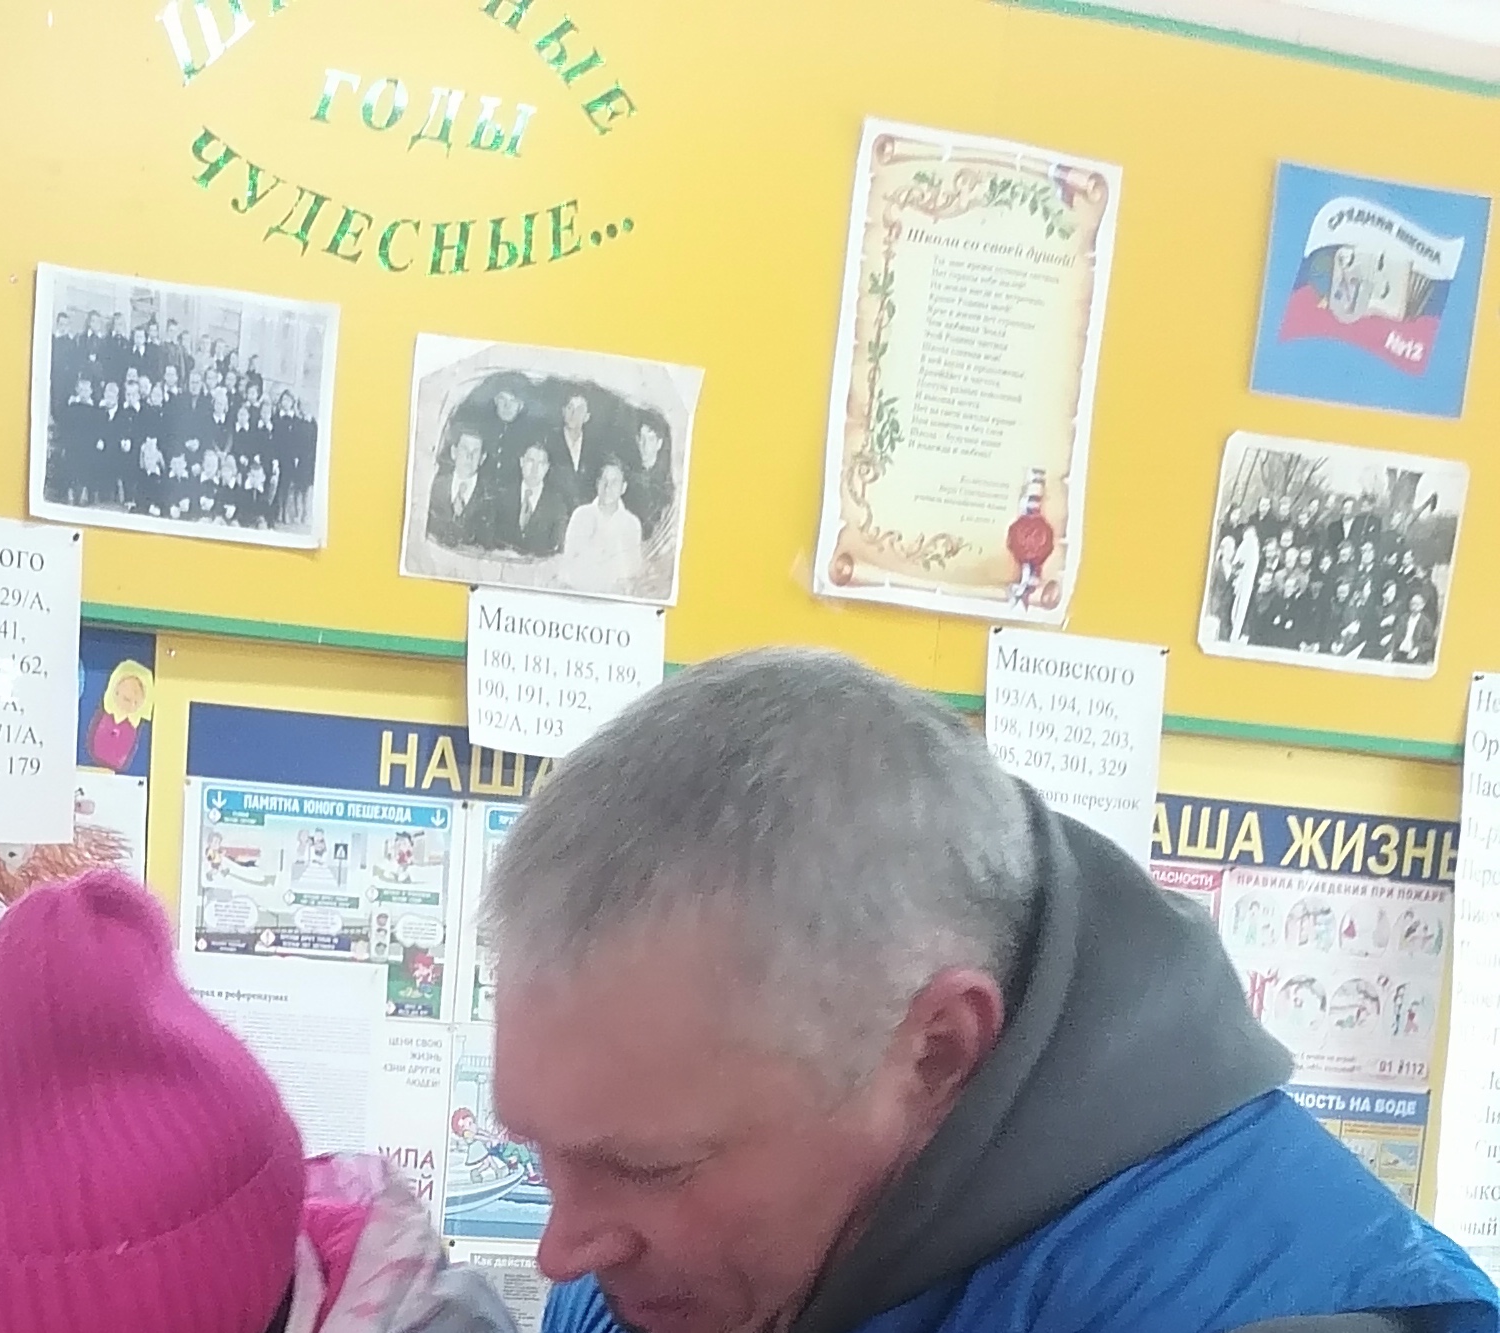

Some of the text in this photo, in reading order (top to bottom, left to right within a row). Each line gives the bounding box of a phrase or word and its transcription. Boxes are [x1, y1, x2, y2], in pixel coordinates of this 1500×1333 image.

[310, 69, 538, 158] ГОДЫ
[478, 605, 631, 648] Маковского
[10, 653, 49, 678] 62,
[996, 645, 1136, 687] Маковского
[536, 717, 564, 738] 193
[8, 757, 41, 777] 179
[378, 730, 553, 799] НАШ
[243, 793, 413, 824] ПАМЯТКА ЮНОГО ПЕШЕХОДА
[1152, 802, 1265, 864] АША
[1152, 868, 1214, 889] ПАСНОСТИ
[1288, 1092, 1418, 1118] НОСТЬ НА ВОДЕ
